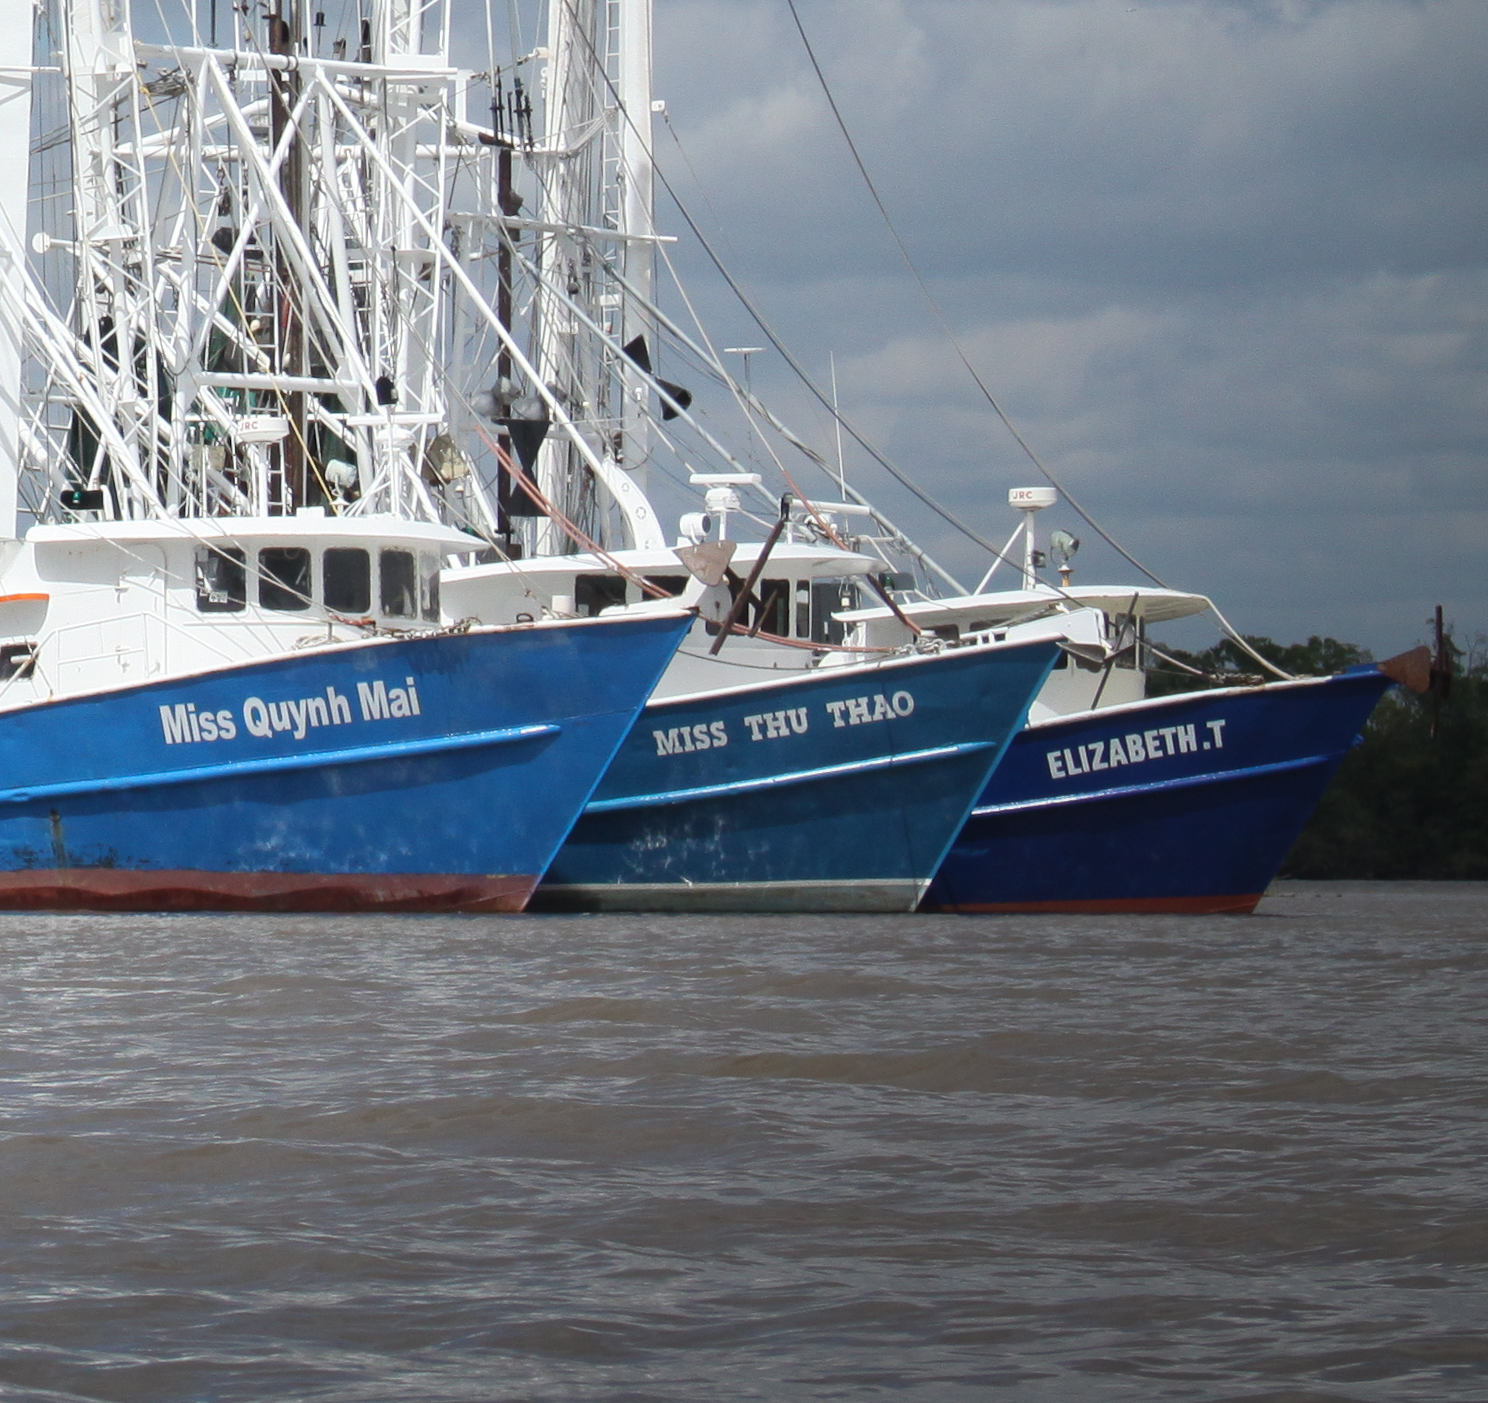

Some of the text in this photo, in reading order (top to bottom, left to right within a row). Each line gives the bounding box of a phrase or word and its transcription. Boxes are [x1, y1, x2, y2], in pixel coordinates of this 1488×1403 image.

[240, 421, 259, 432] JRC
[1013, 490, 1033, 500] JRC
[159, 676, 421, 745] Miss Quynh Mai
[652, 690, 915, 756] MISS THU THAO
